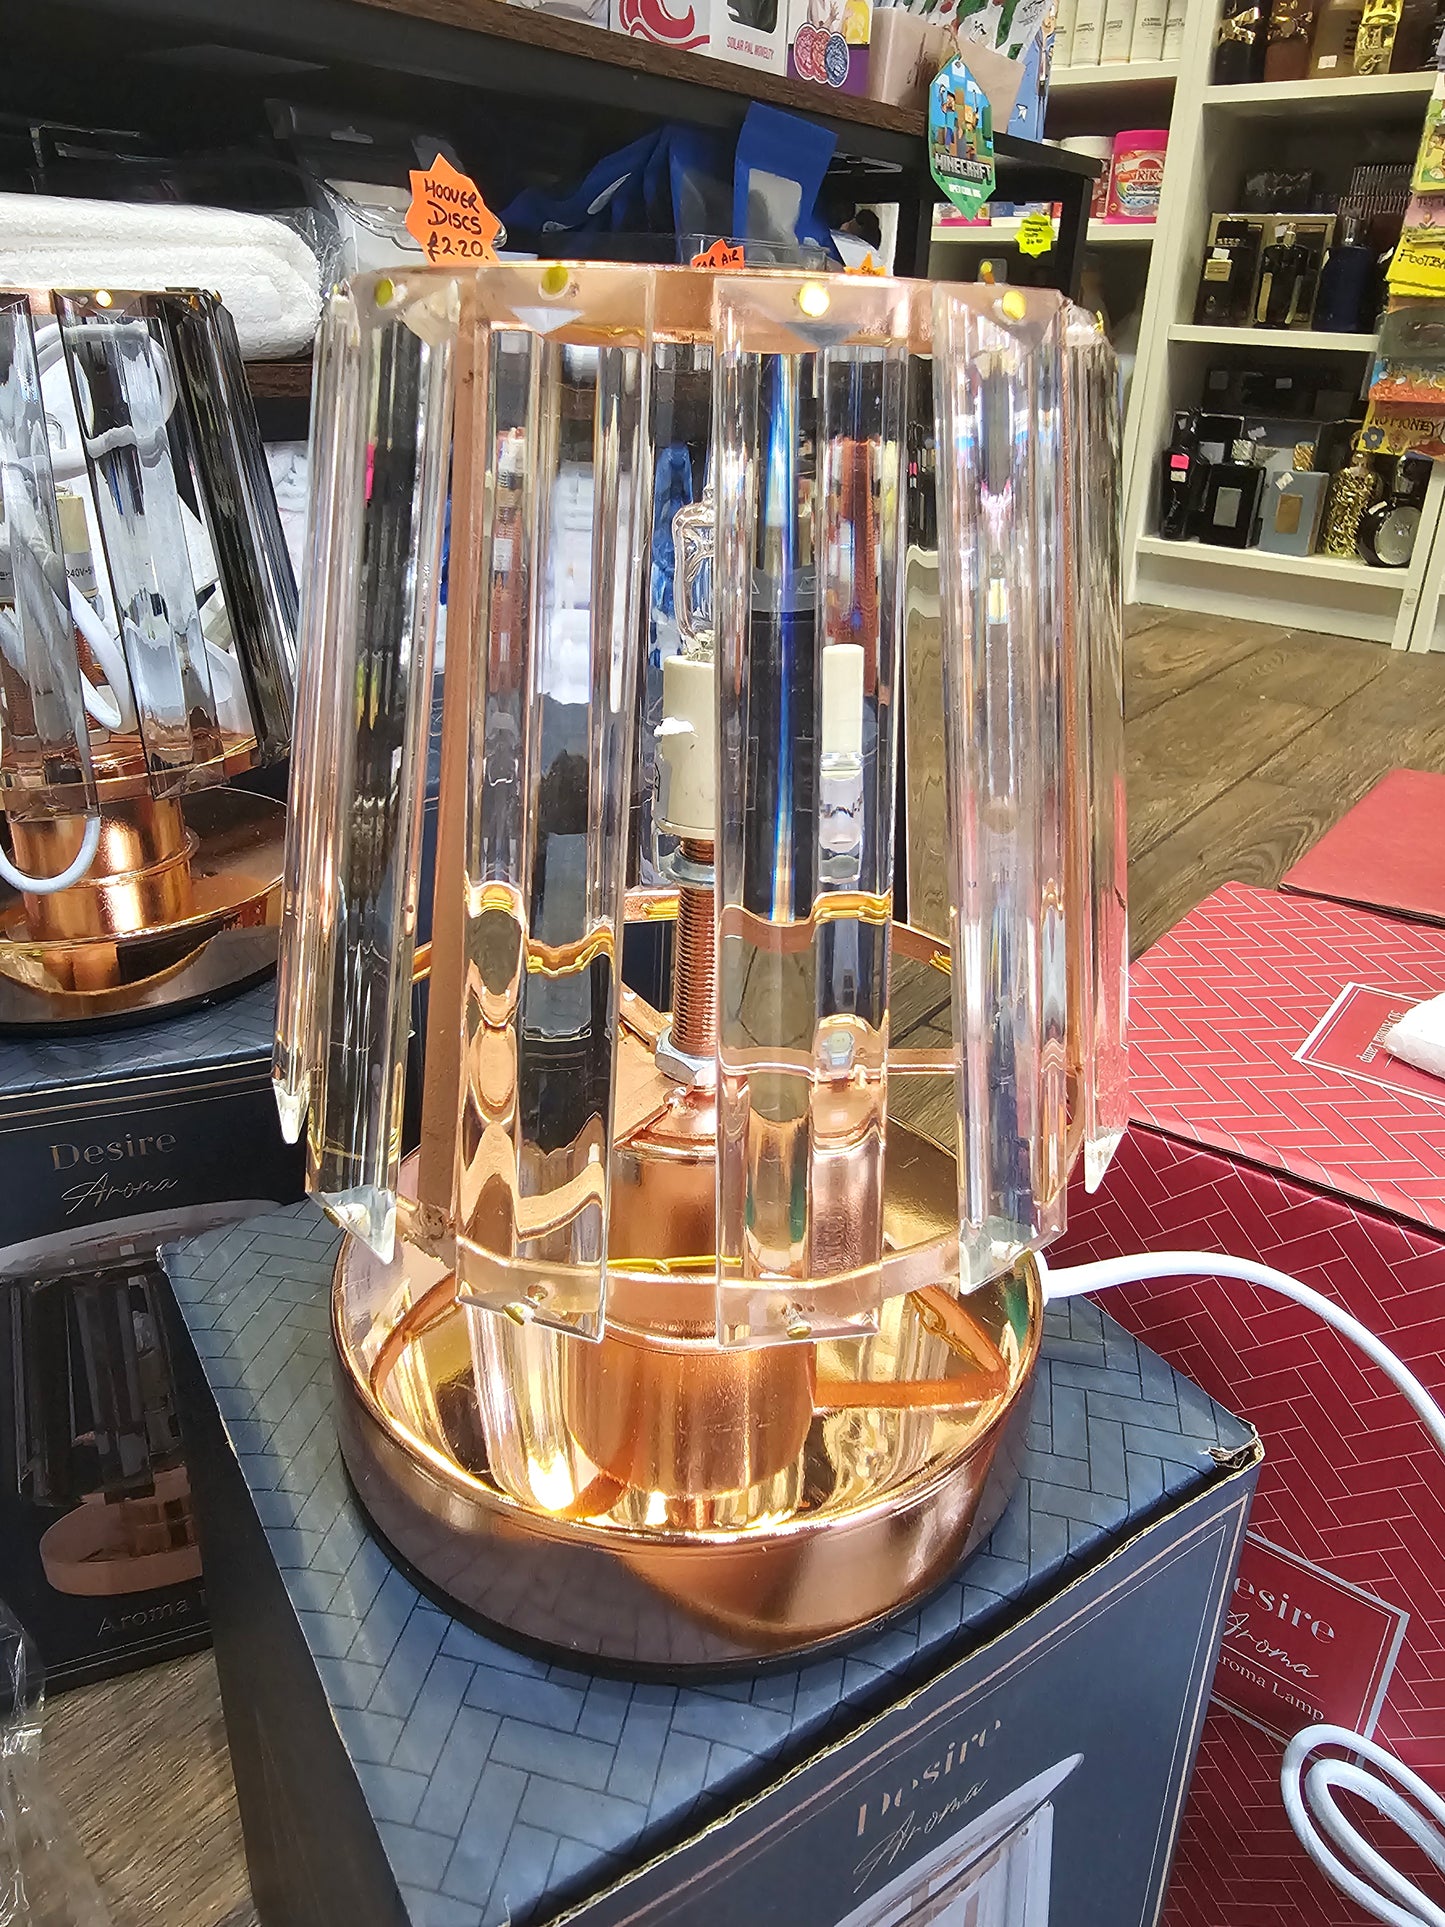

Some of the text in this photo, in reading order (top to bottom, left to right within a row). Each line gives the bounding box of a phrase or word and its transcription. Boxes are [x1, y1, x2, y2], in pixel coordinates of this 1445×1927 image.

[727, 36, 743, 51] SOLAR
[934, 153, 992, 185] MINECRAFT
[423, 178, 480, 214] HOOVER
[427, 200, 482, 235] DISCS
[721, 249, 739, 266] AIR
[1389, 416, 1441, 438] MONEY
[50, 1133, 177, 1171] Desire
[61, 1172, 179, 1216] Aroma
[97, 1599, 192, 1638] Aroma
[1233, 1577, 1335, 1644] esire
[1271, 1681, 1325, 1721] Lamp
[856, 1719, 1001, 1837] Desire
[852, 1779, 989, 1894] Aroma
